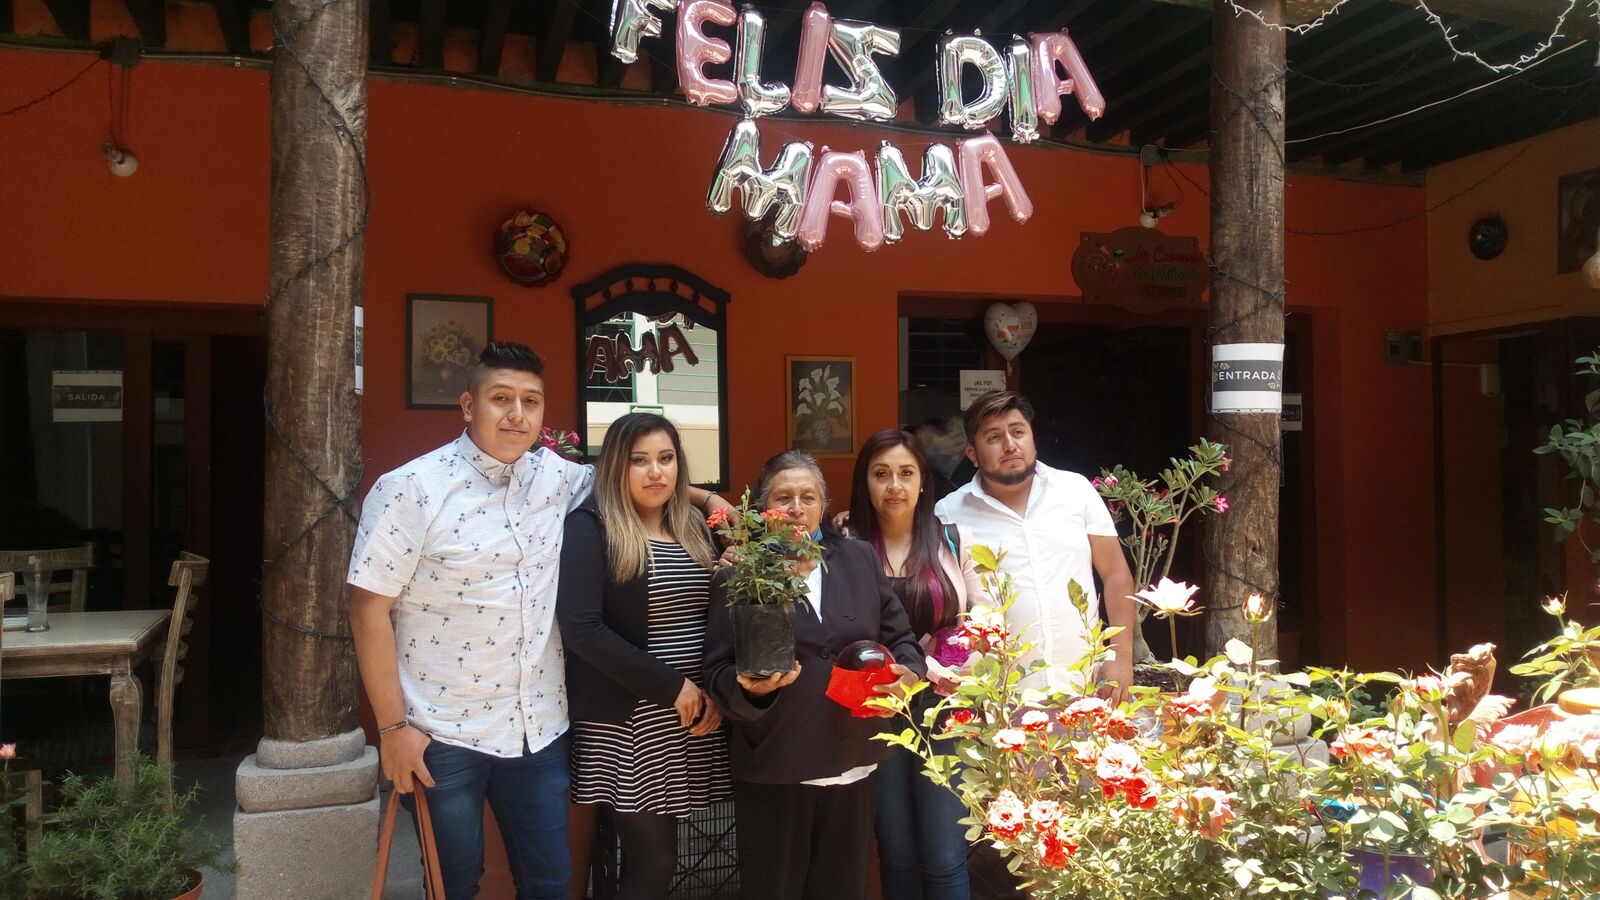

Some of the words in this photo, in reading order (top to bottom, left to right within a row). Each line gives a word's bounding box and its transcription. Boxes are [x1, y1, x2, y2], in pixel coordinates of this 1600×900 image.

[936, 27, 1106, 143] DIA
[707, 119, 1034, 252] MAMA
[68, 393, 105, 401] SALIDA
[1218, 370, 1276, 380] ENTRADA
